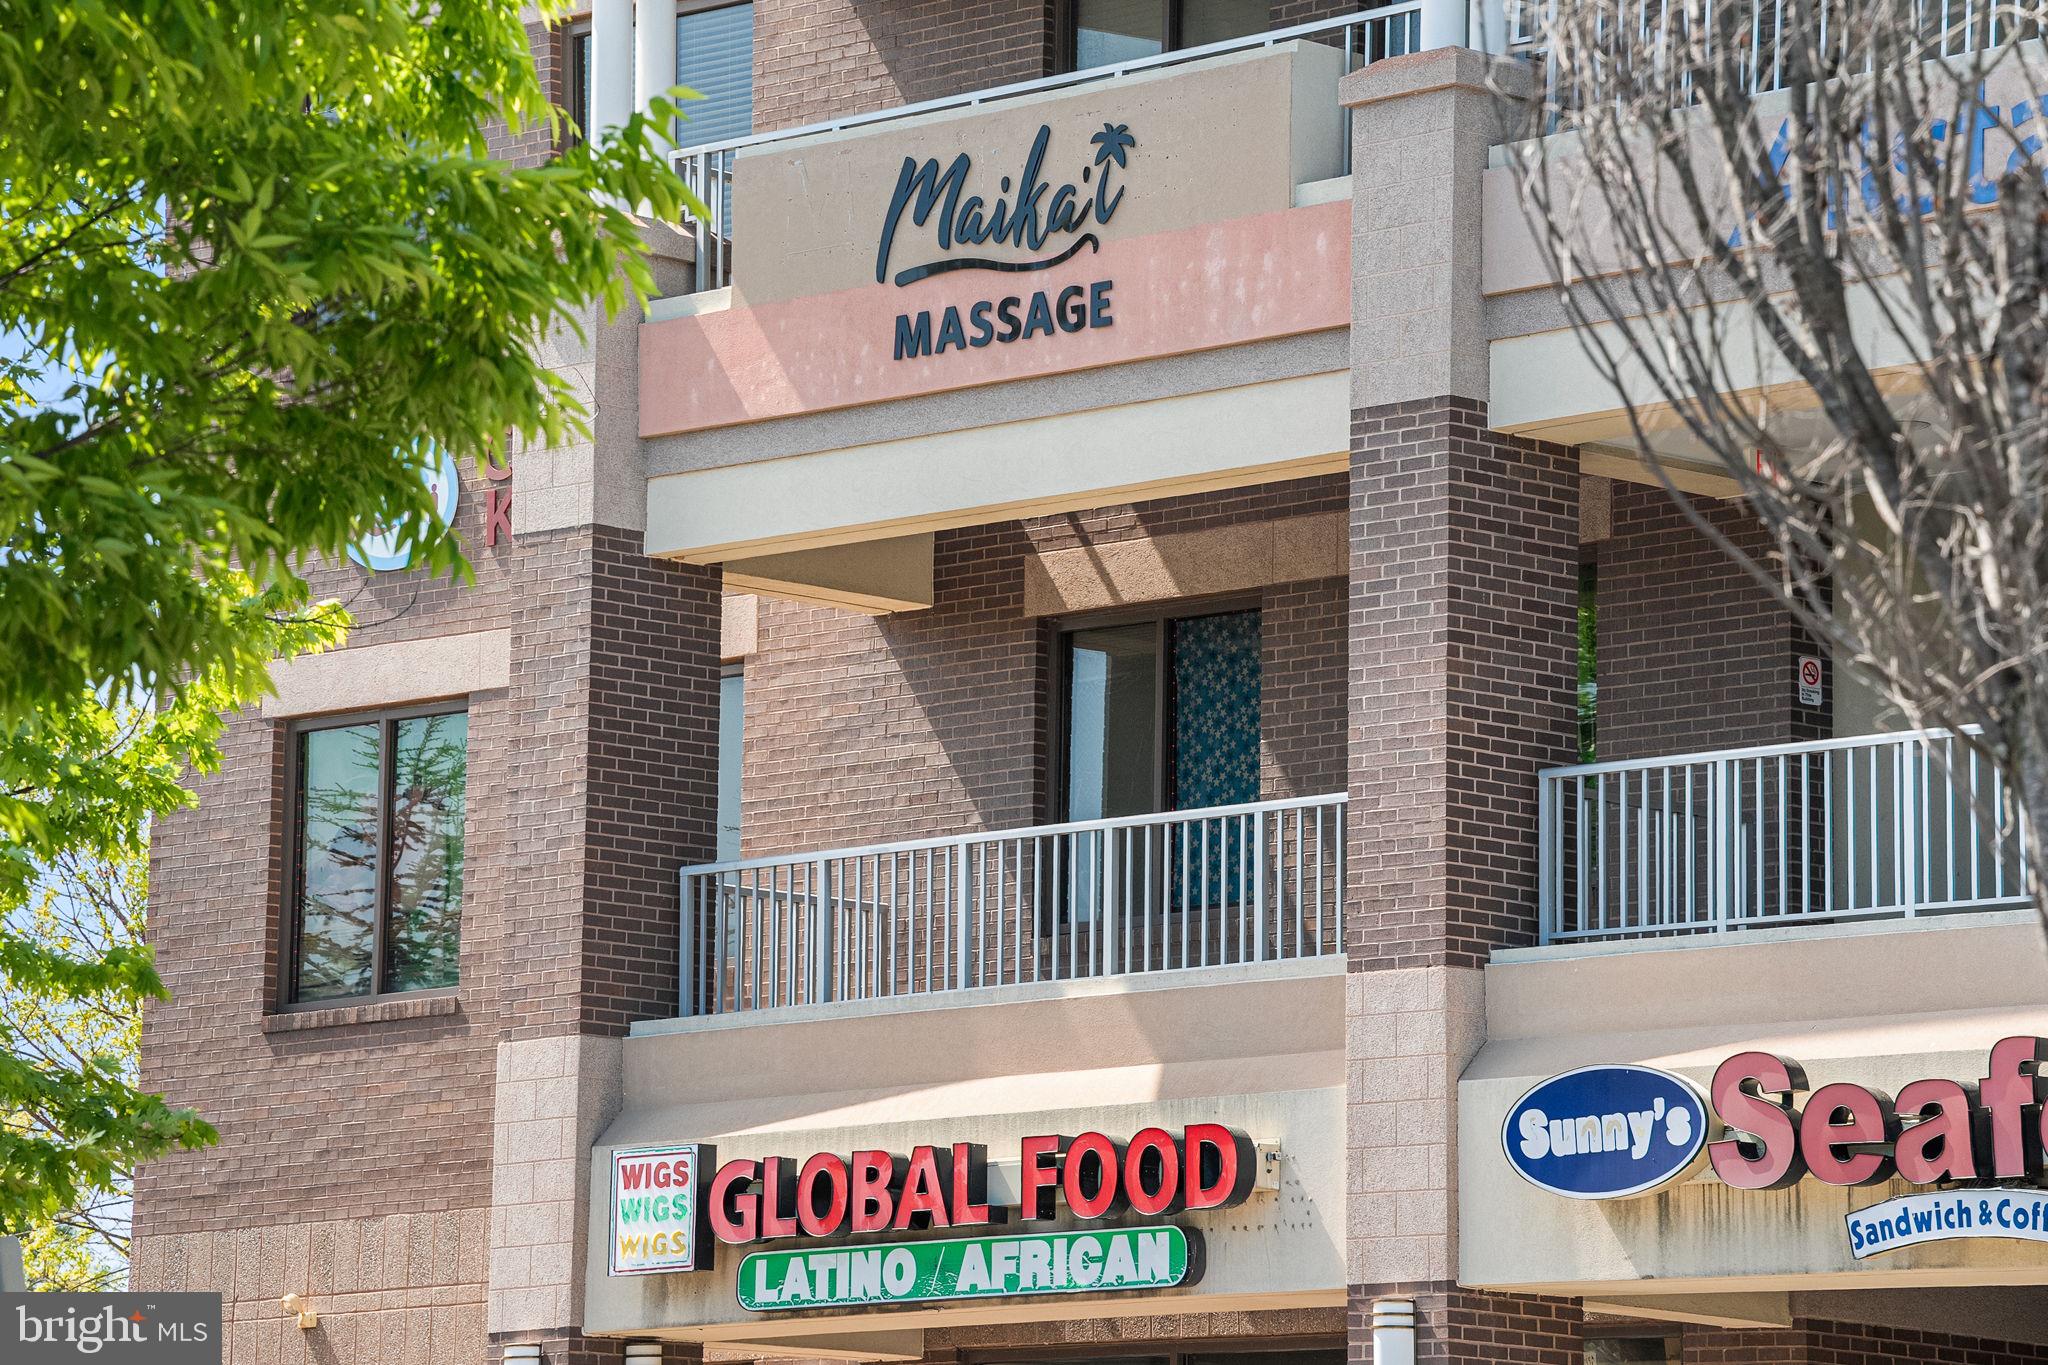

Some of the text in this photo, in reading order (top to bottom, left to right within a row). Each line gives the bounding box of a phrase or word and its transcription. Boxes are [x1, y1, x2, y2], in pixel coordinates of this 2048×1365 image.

[893, 280, 1114, 361] MASSAGE
[1519, 1097, 1692, 1160] Sunny's
[1707, 1036, 2048, 1190] Seaf
[621, 1160, 689, 1191] WIGS
[708, 1123, 1241, 1244] GLOBAL FOOD
[620, 1193, 688, 1225] WIGS
[1849, 1199, 1973, 1251] Sandwich
[1978, 1199, 1993, 1226] &
[619, 1230, 687, 1260] WIGS
[755, 1247, 917, 1303] LATINO
[955, 1231, 1172, 1287] AFRICAN
